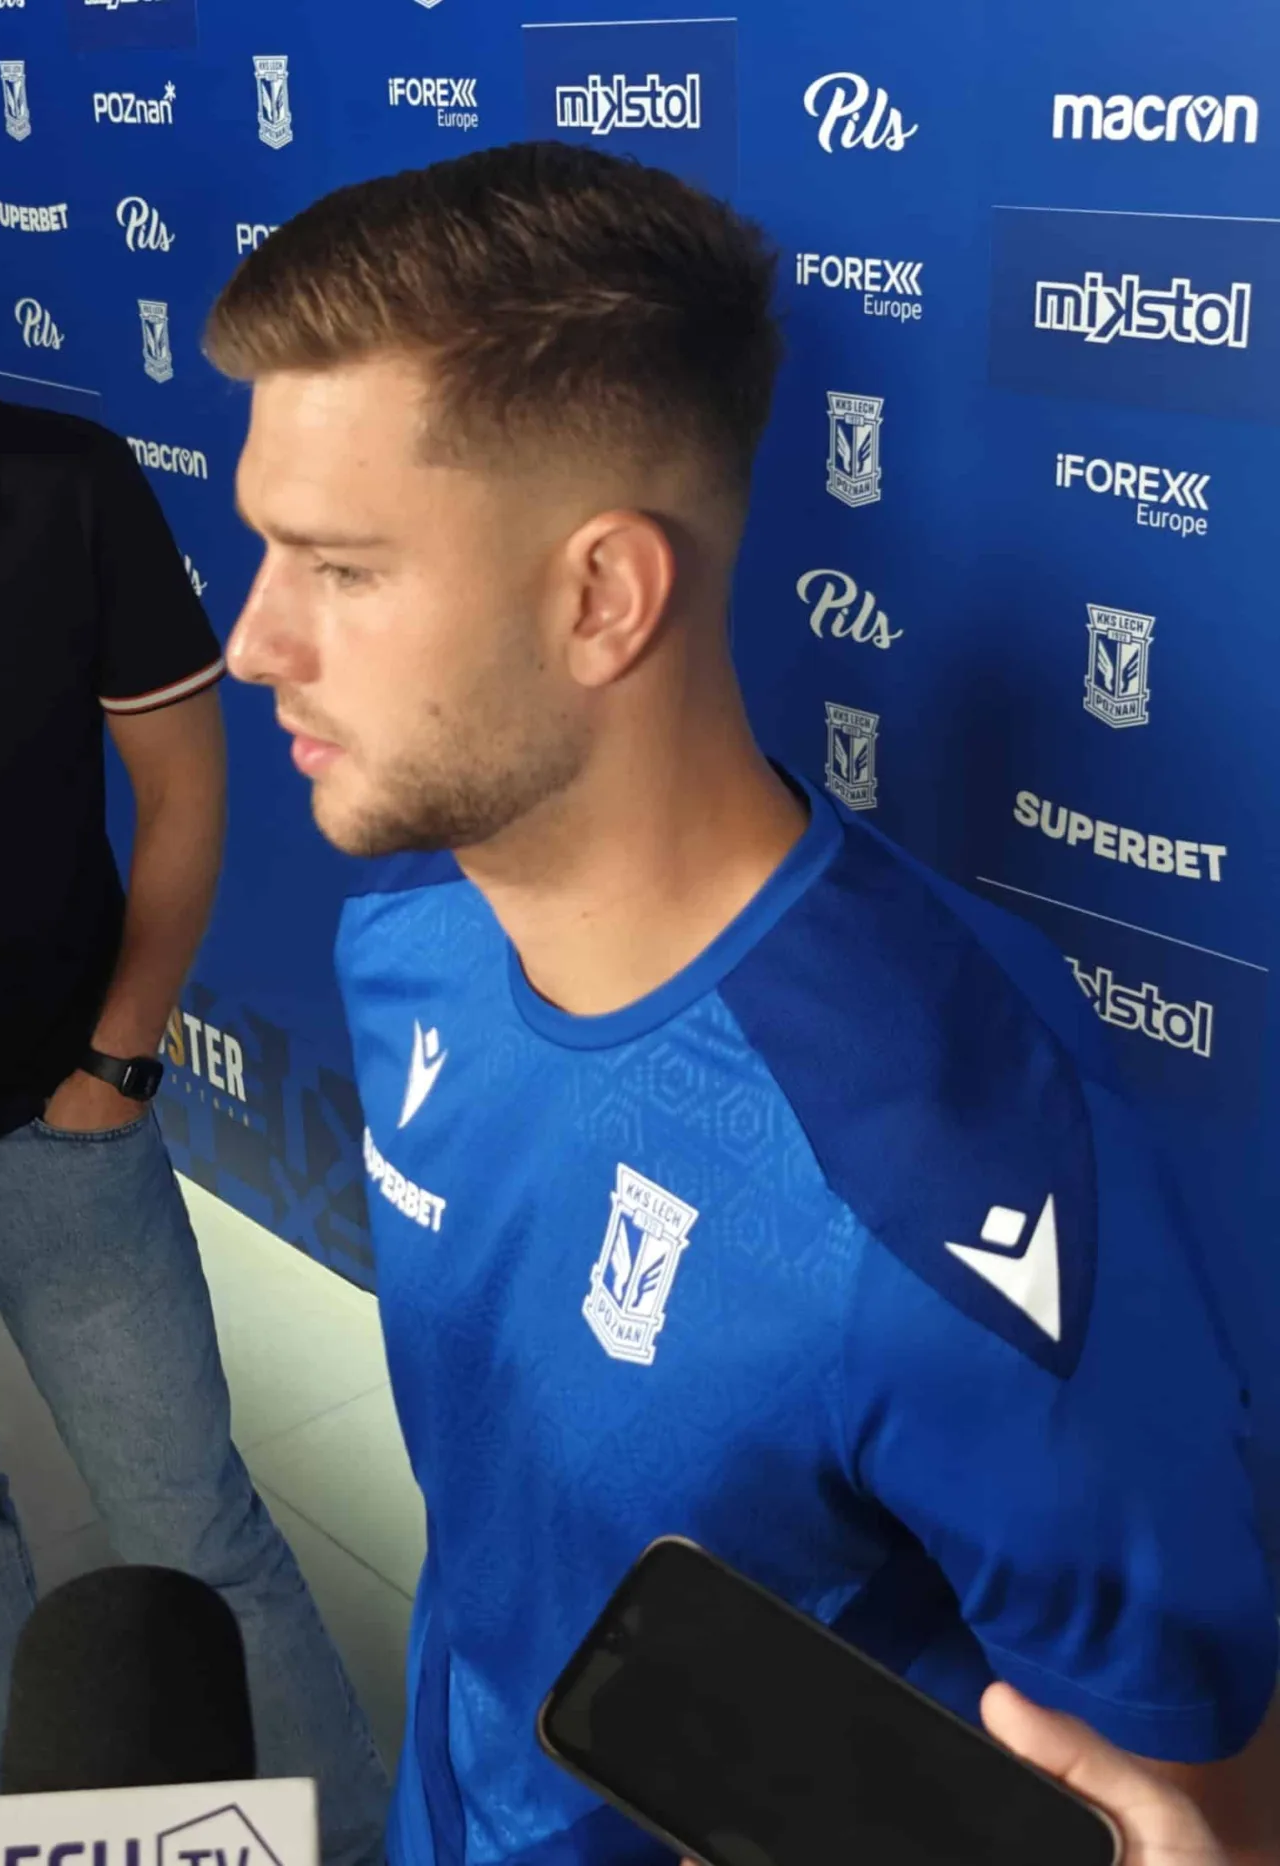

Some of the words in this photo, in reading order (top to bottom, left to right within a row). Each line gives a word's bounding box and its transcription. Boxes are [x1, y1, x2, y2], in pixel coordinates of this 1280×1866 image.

[388, 78, 477, 107] iFOREX
[556, 74, 700, 135] mikstol
[803, 72, 918, 153] Pils
[1052, 94, 1258, 143] macron
[437, 109, 478, 131] Europe
[116, 196, 175, 252] Pils
[796, 253, 923, 296] iFOREX
[14, 298, 65, 350] Pils
[863, 294, 923, 323] Europe
[1035, 272, 1251, 349] mikstol
[1056, 453, 1211, 510] iFOREX
[1136, 503, 1208, 537] Europe
[796, 568, 904, 649] Pils
[1097, 611, 1117, 627] KKS
[1119, 618, 1144, 633] LECH
[1014, 791, 1227, 882] SUPERBET
[1064, 956, 1213, 1057] kstol
[363, 1125, 446, 1232] UPERBET
[625, 1182, 651, 1208] KKS
[652, 1197, 682, 1229] LECH
